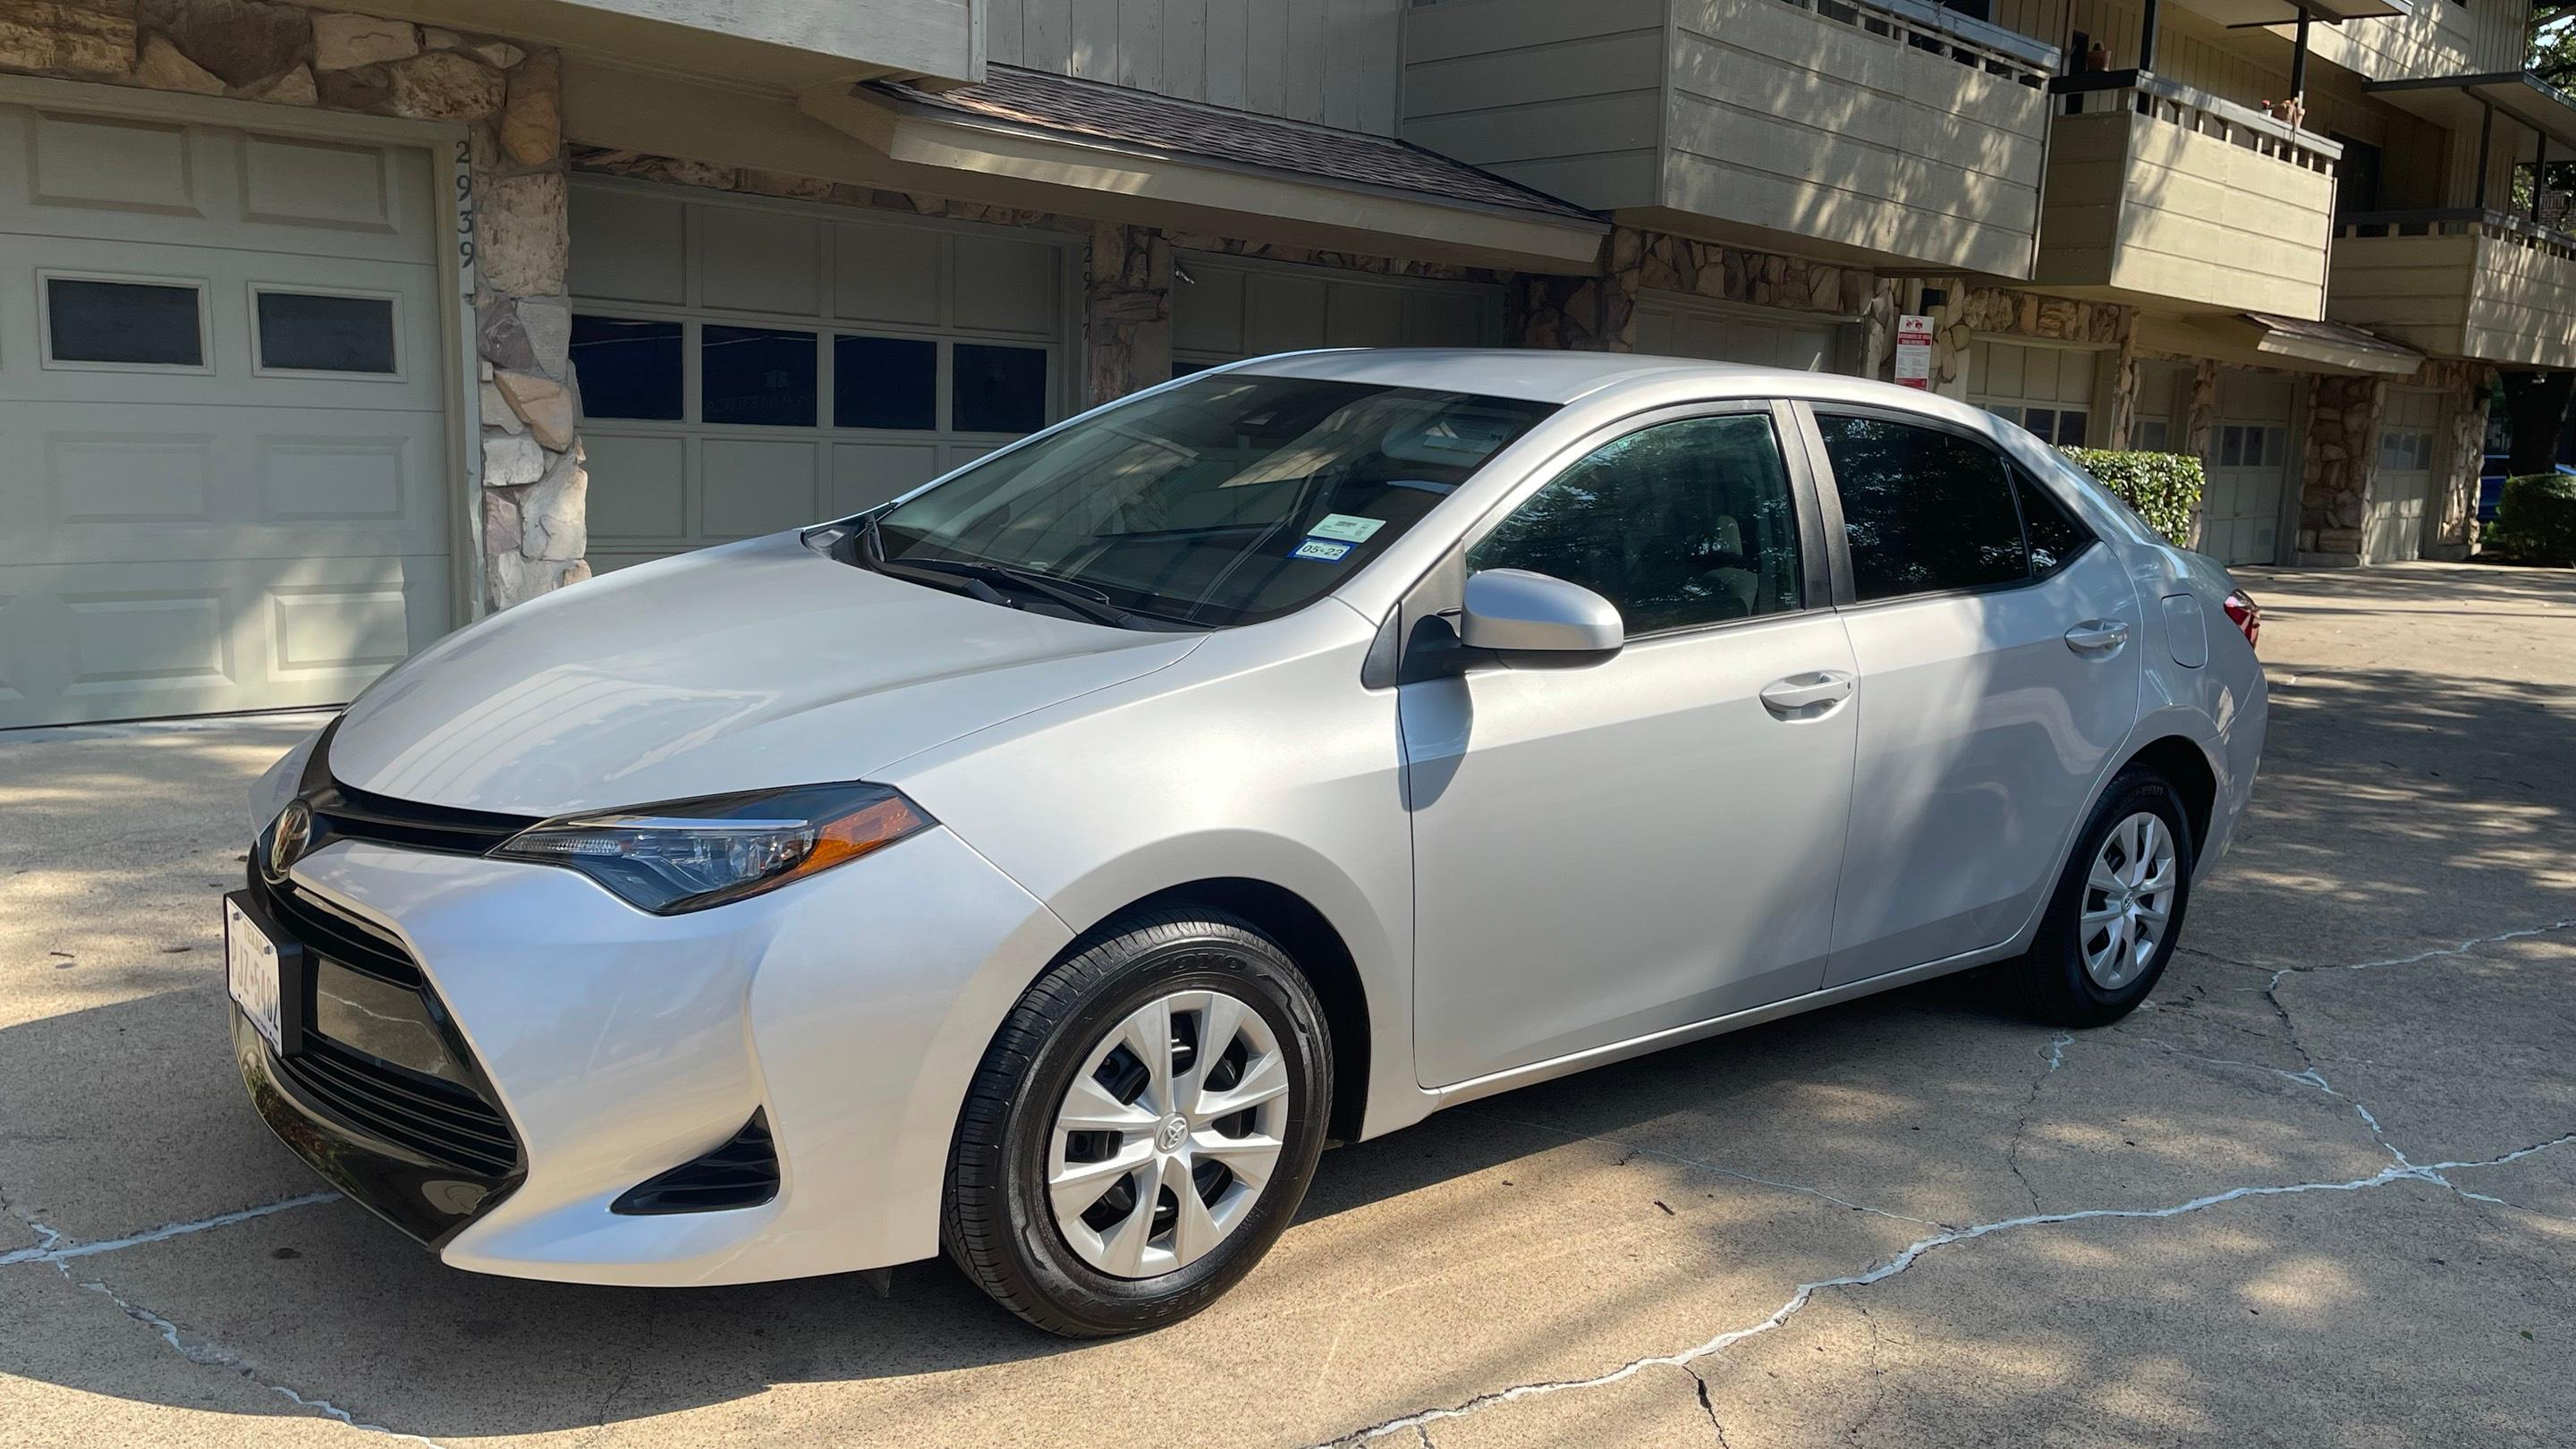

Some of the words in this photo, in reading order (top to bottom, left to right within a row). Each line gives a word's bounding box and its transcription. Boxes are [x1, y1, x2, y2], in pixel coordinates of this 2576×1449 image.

[456, 141, 474, 268] 2939
[1301, 545, 1321, 554] 05
[1325, 547, 1343, 556] 22
[242, 919, 264, 957] TEXAS
